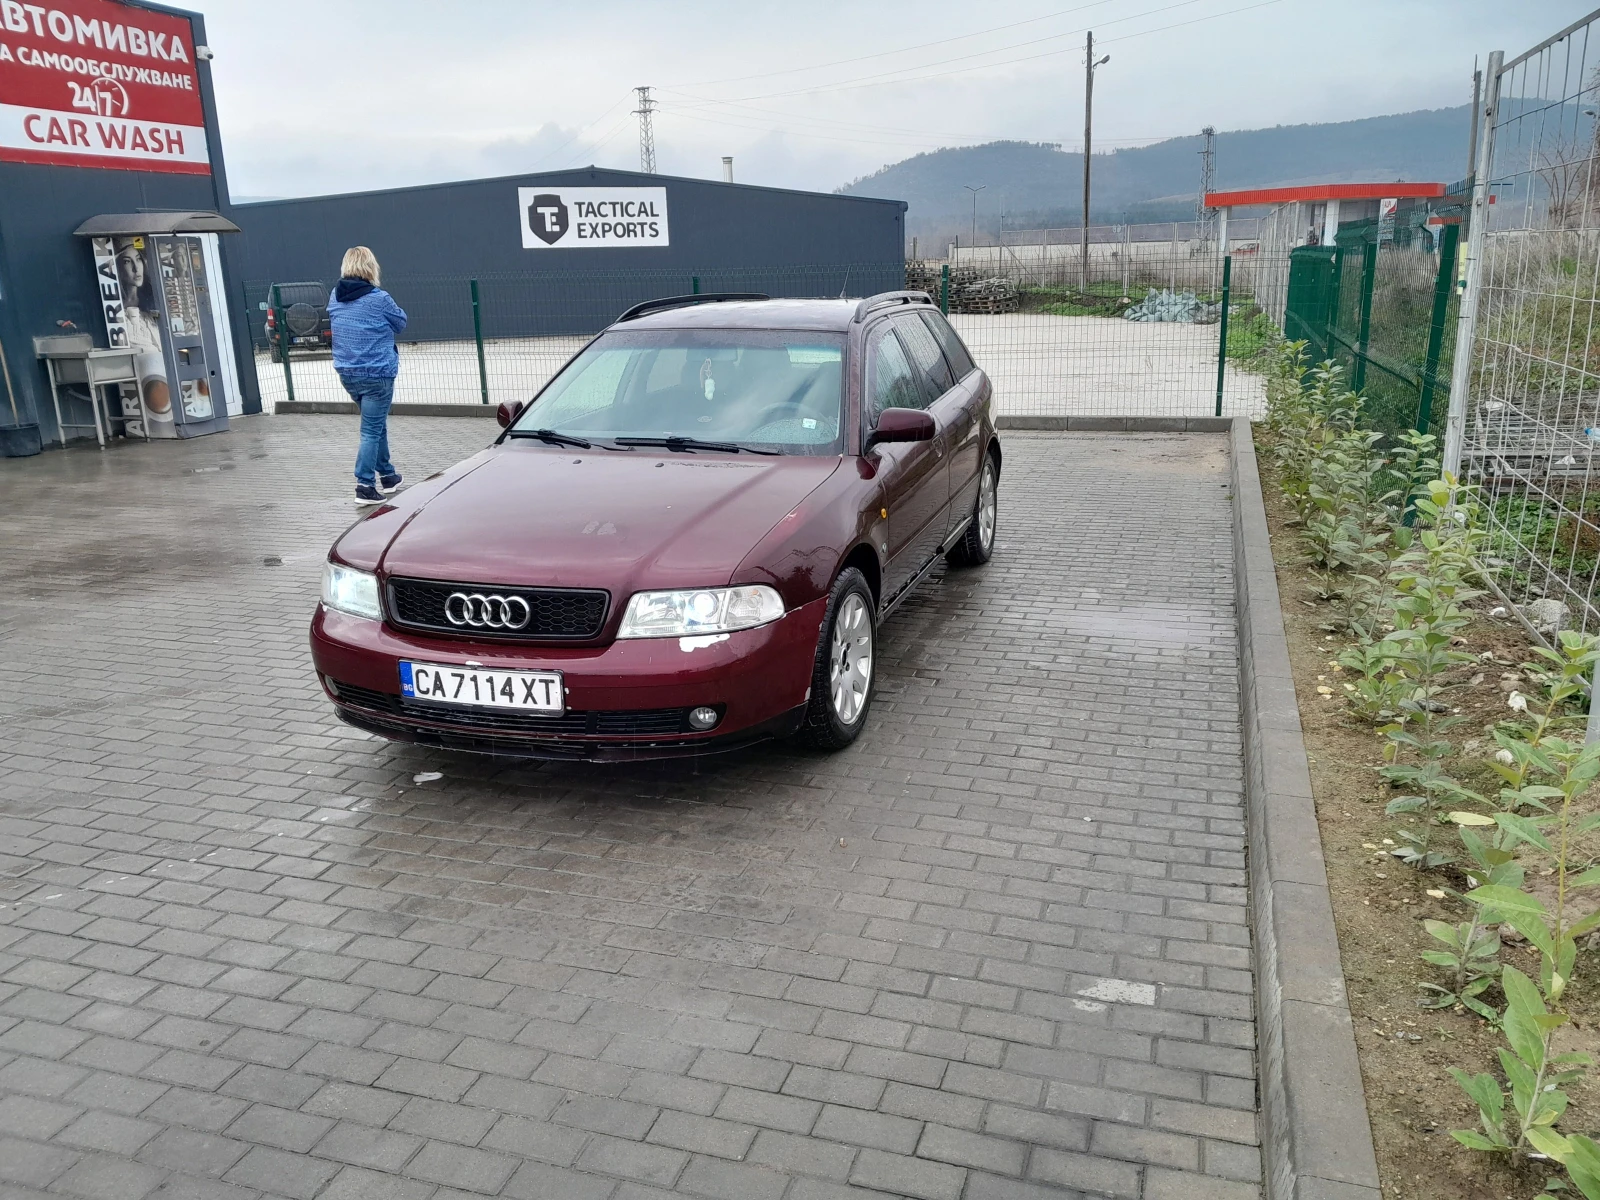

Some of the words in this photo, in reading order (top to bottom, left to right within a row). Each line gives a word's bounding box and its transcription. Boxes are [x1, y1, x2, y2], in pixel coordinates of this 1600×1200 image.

[0, 0, 189, 63] ВТОМИВКА
[17, 46, 193, 90] САМООБСЛУЖВАНЕ
[23, 114, 90, 147] CAR
[96, 121, 185, 155] WASH
[574, 201, 660, 218] TACTICAL
[577, 222, 660, 239] EXPORTS
[93, 238, 129, 347] BREAK
[119, 382, 146, 438] ART
